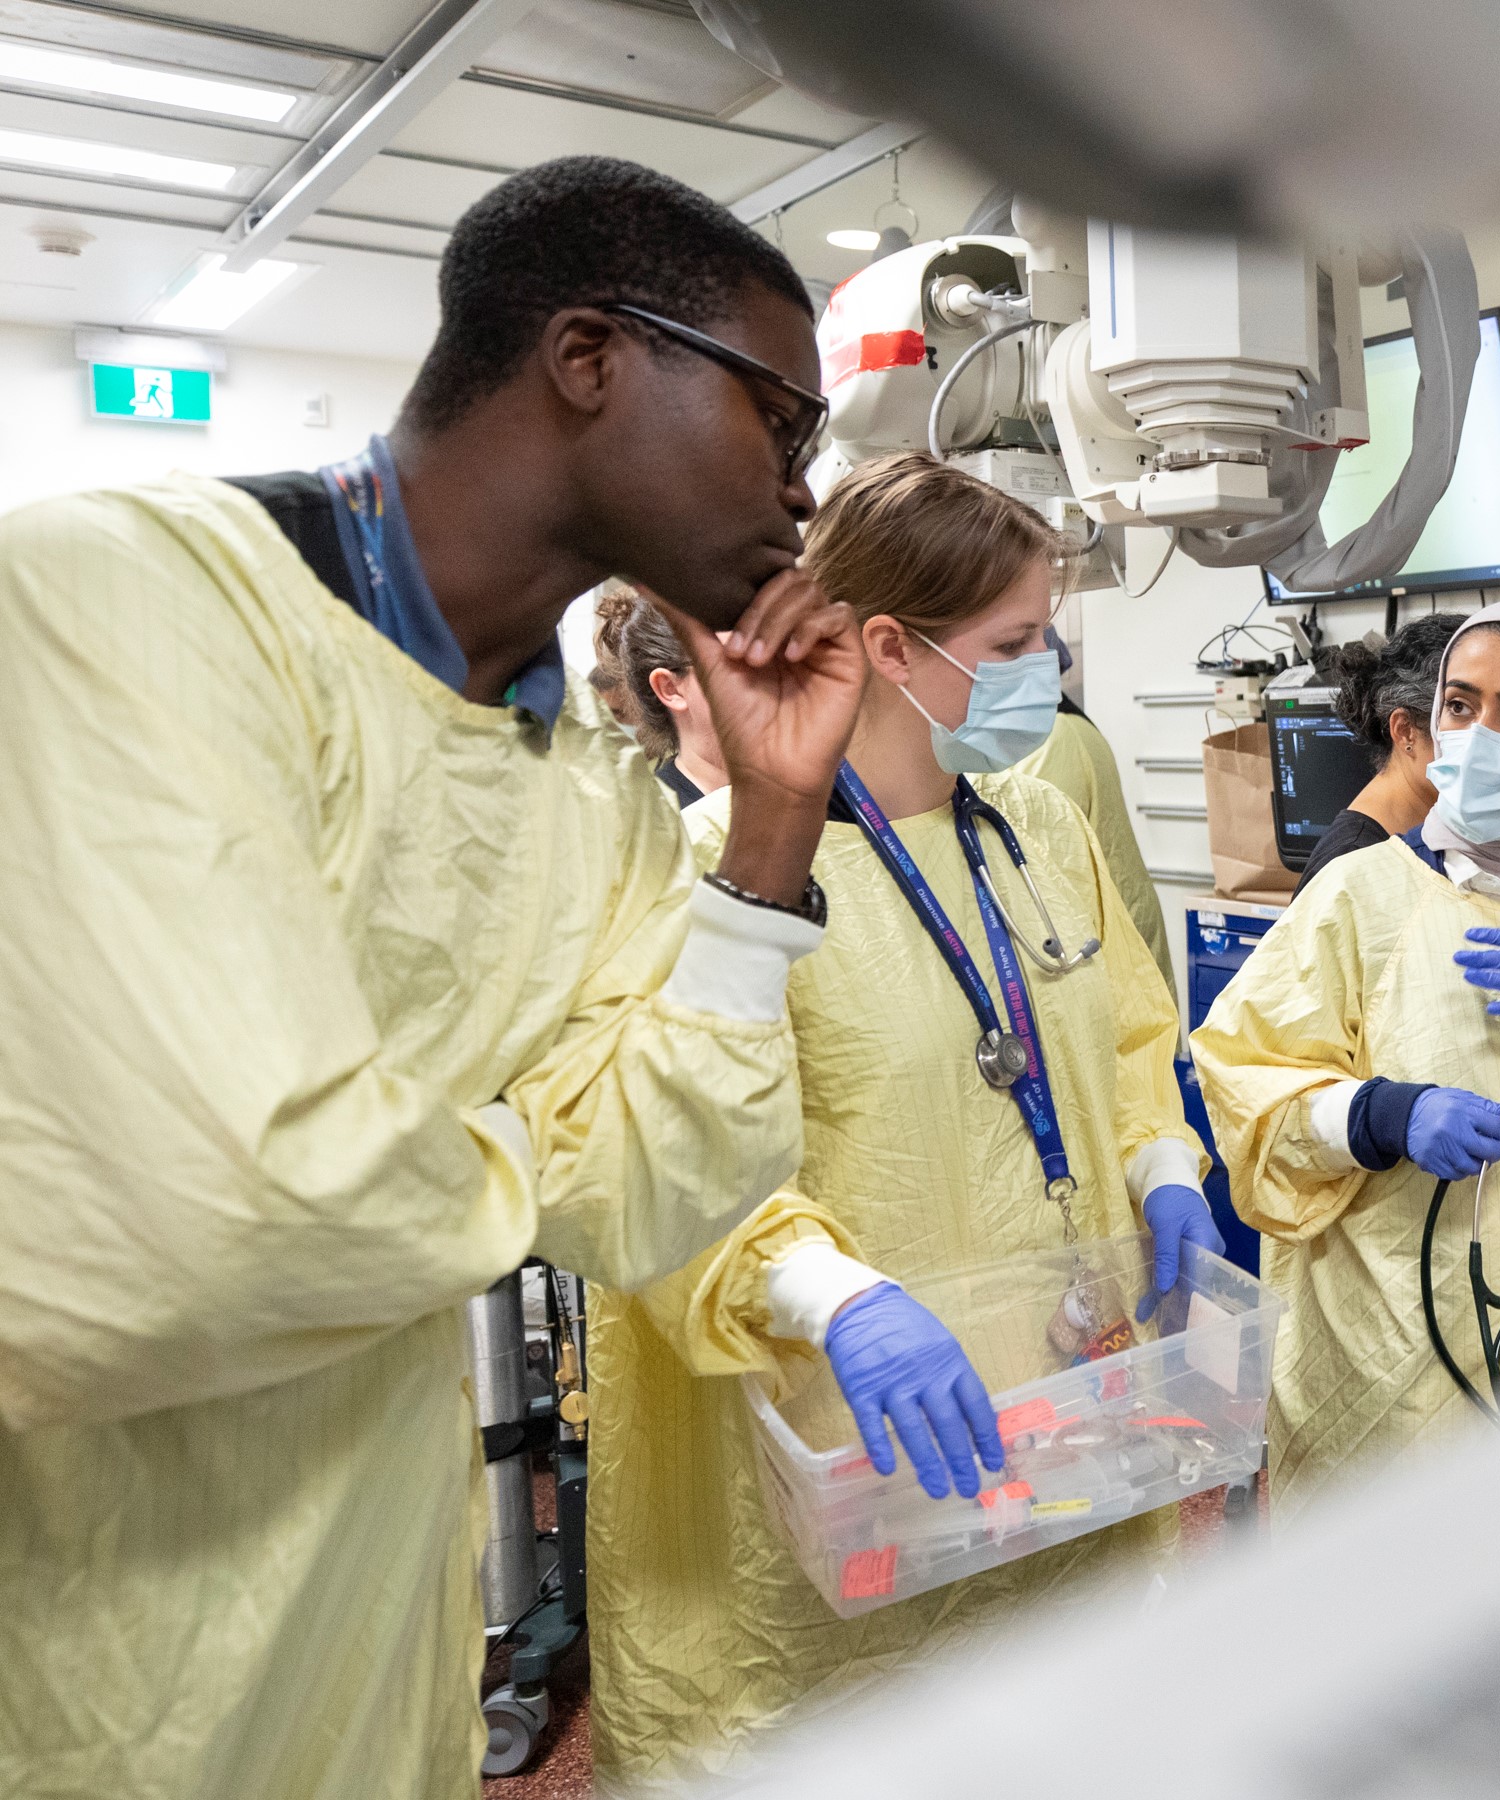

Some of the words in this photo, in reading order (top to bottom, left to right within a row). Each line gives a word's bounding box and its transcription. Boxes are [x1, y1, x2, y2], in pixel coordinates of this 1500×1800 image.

[916, 888, 945, 930] Diagnose
[998, 946, 1011, 970] here
[1007, 981, 1023, 1012] HEALTH
[1014, 1010, 1030, 1036] CHILD
